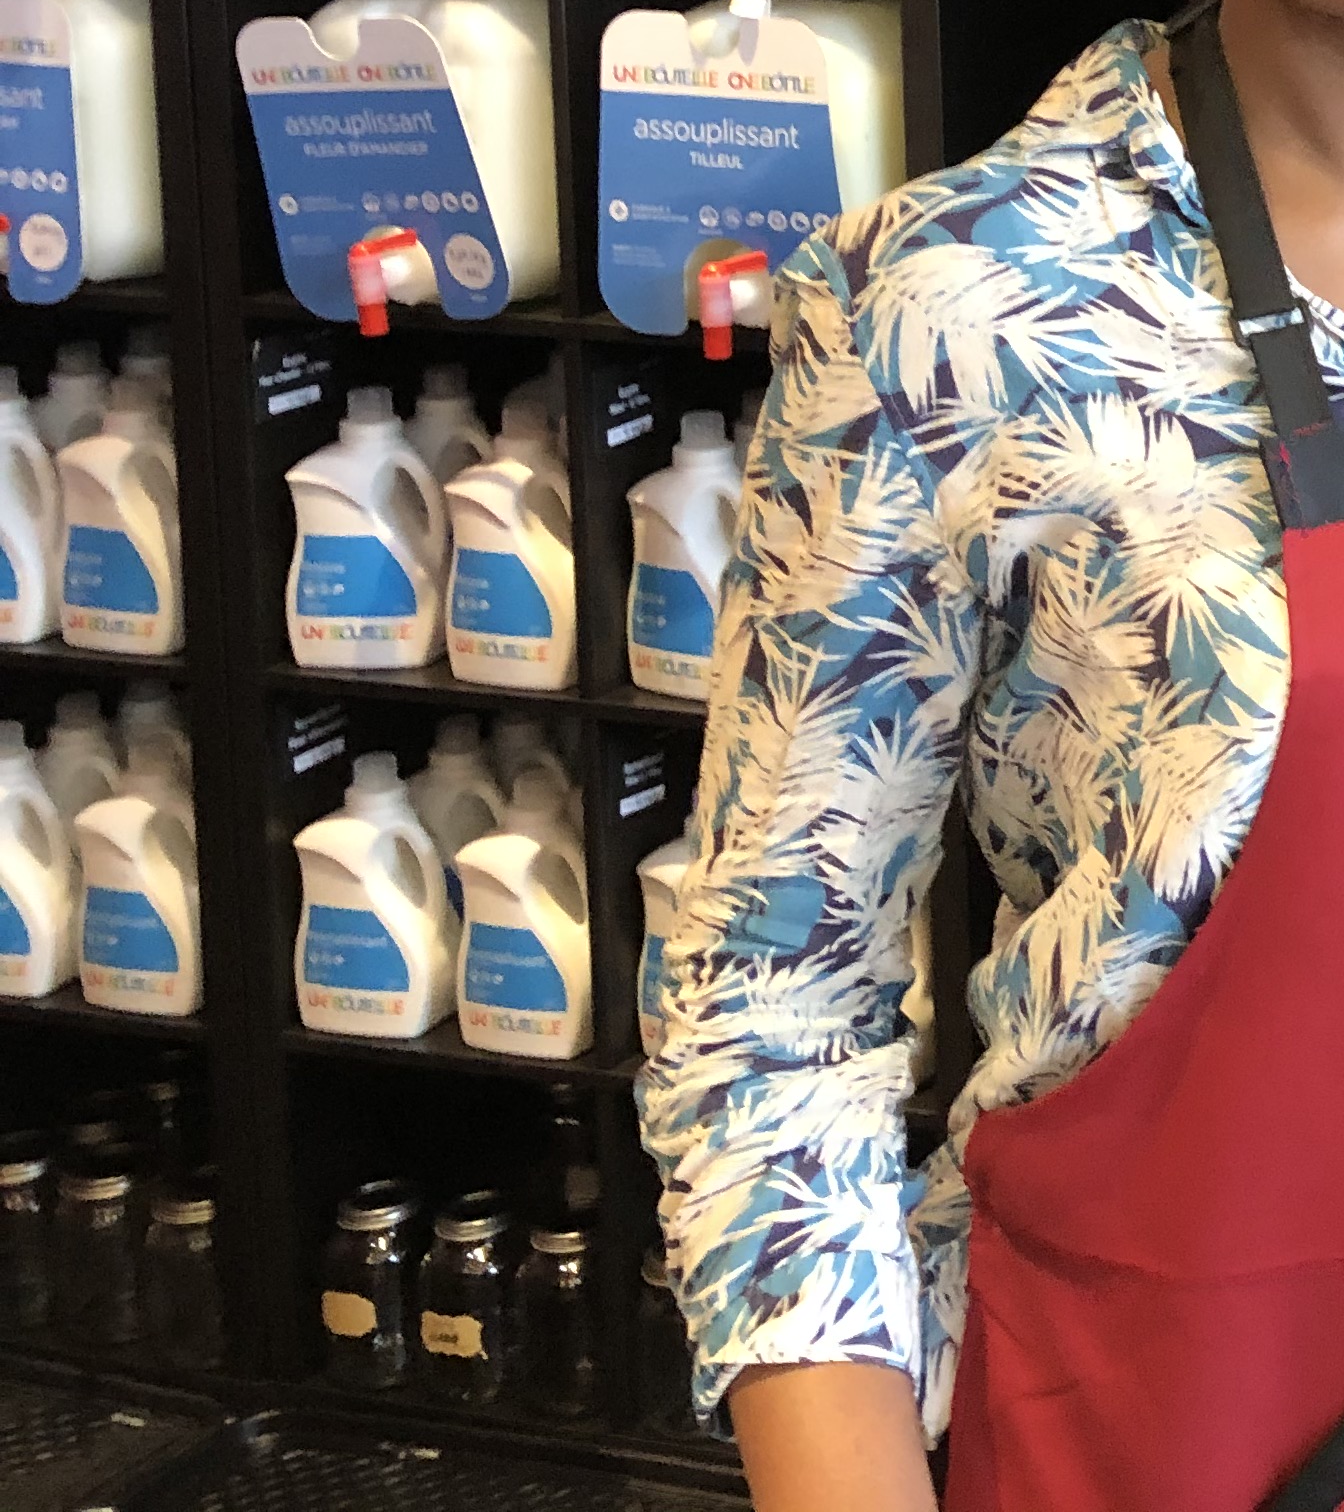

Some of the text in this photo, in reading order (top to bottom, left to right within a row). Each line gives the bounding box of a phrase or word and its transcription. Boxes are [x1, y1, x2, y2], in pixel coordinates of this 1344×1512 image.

[284, 108, 437, 138] assouplissant
[633, 116, 800, 149] assouplissant
[689, 150, 744, 170] TILLEUL
